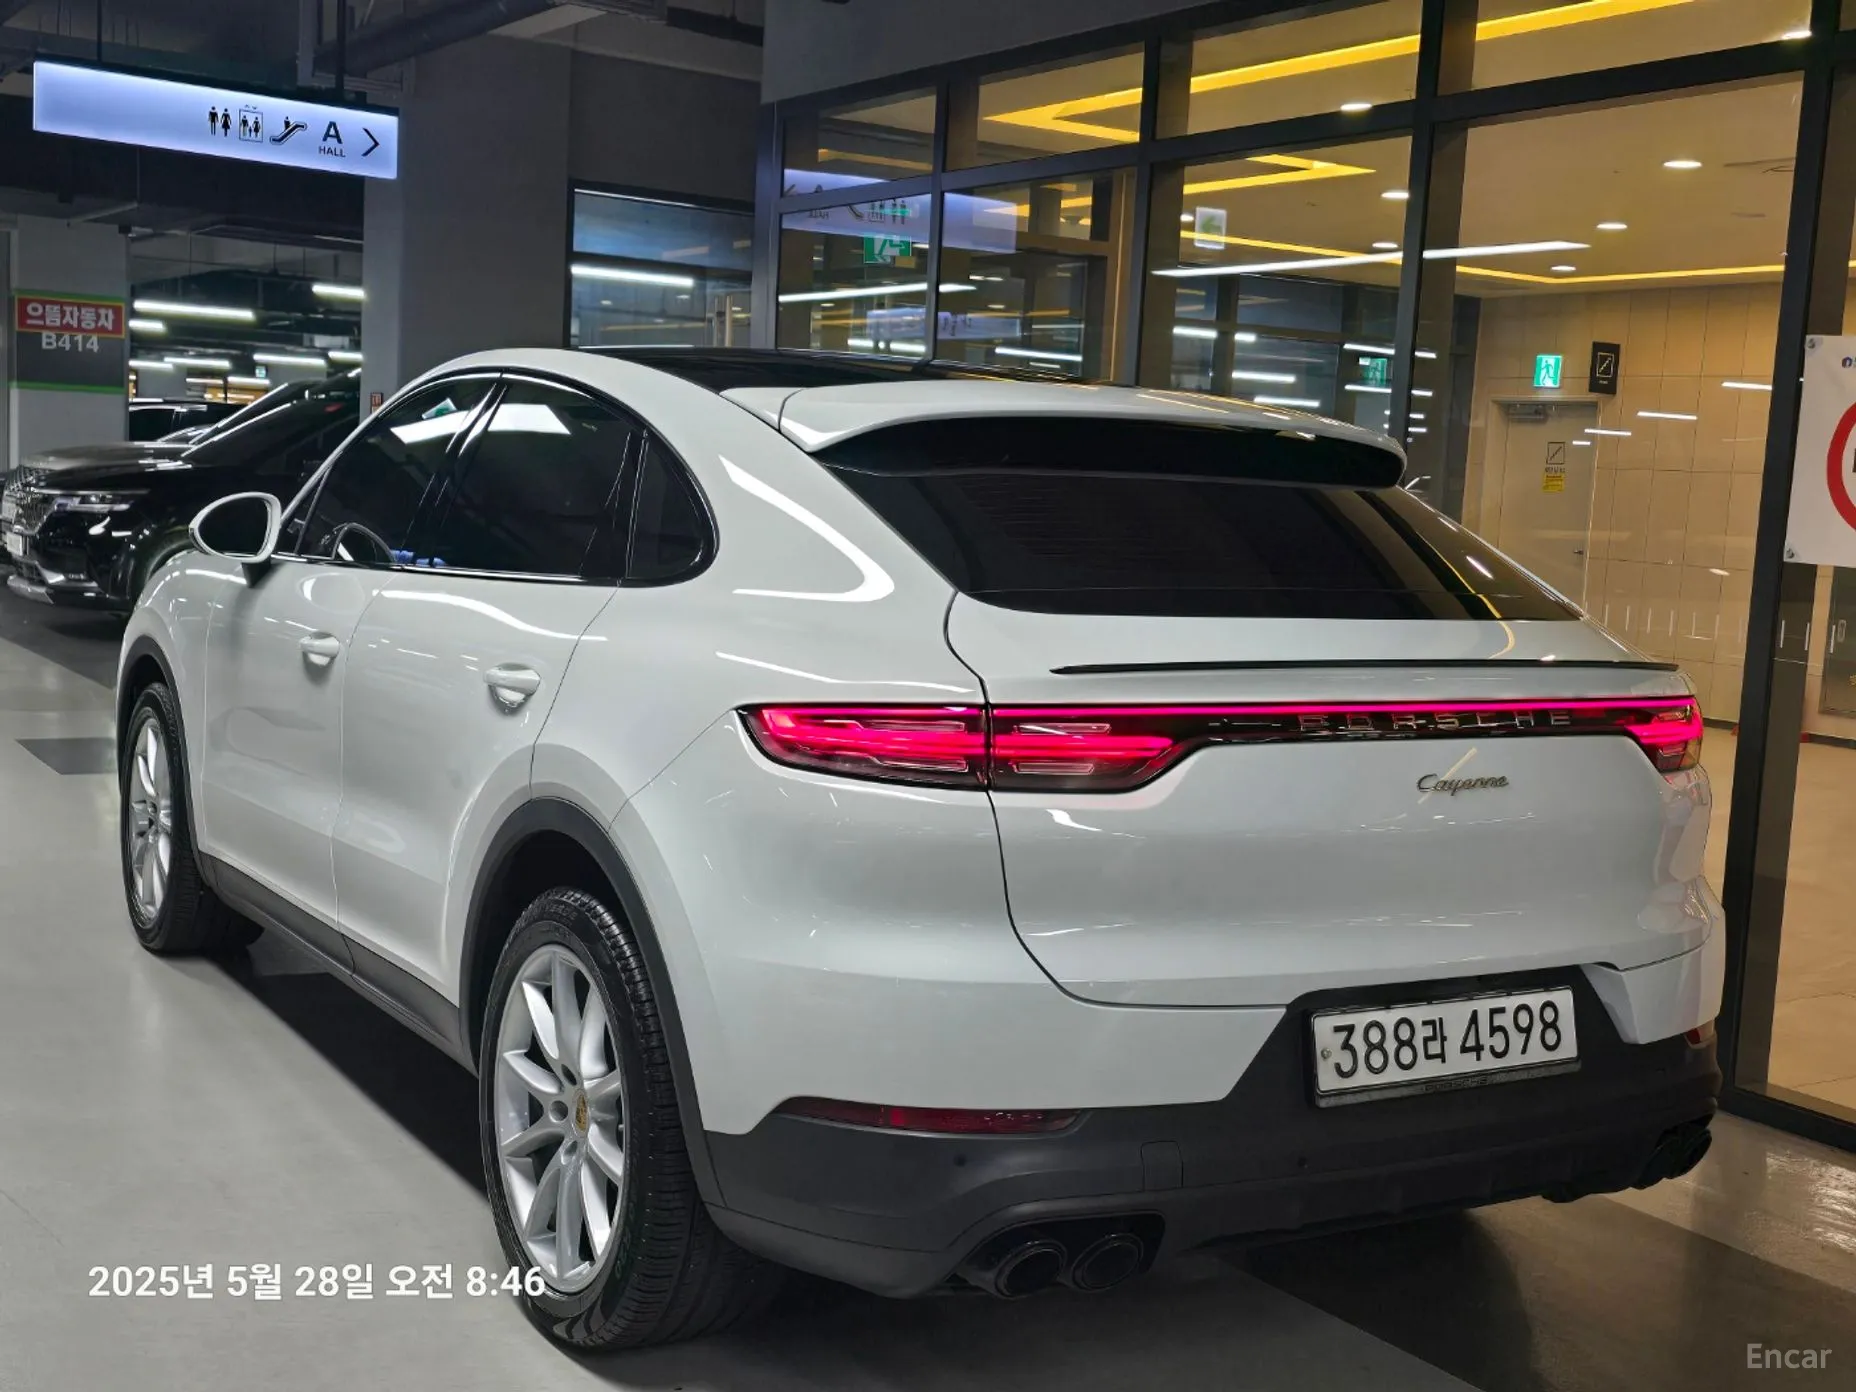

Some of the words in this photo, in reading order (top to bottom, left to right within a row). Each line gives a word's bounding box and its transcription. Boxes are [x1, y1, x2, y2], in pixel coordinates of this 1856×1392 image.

[322, 121, 343, 144] A
[319, 146, 346, 157] HALL
[27, 302, 114, 330] 으뜸자동차
[42, 331, 99, 352] B414
[1417, 774, 1509, 796] Cayenne
[1333, 1017, 1447, 1079] 388라
[1459, 1000, 1561, 1061] 4598
